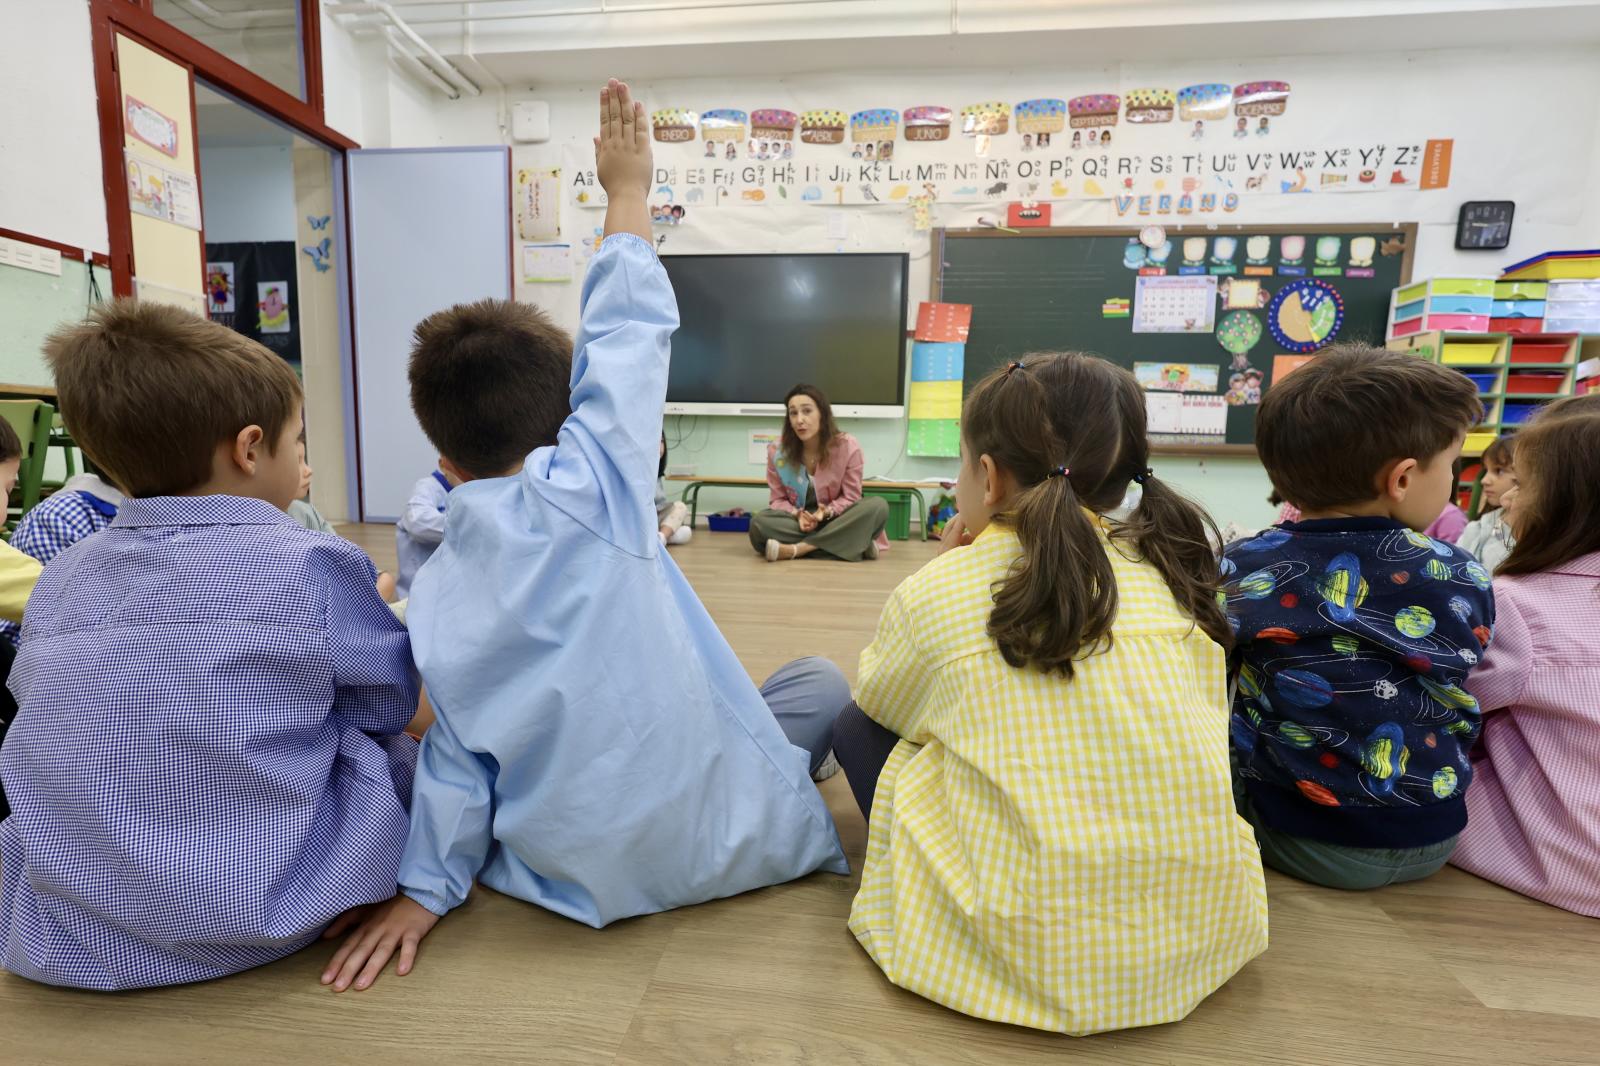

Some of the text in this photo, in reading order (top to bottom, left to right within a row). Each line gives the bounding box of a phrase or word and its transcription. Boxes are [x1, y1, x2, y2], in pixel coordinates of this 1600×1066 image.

[661, 129, 689, 141] ENERO
[810, 132, 833, 141] ABRIL
[1430, 143, 1443, 185] EDELVIVES
[1115, 193, 1239, 216] VERANO
